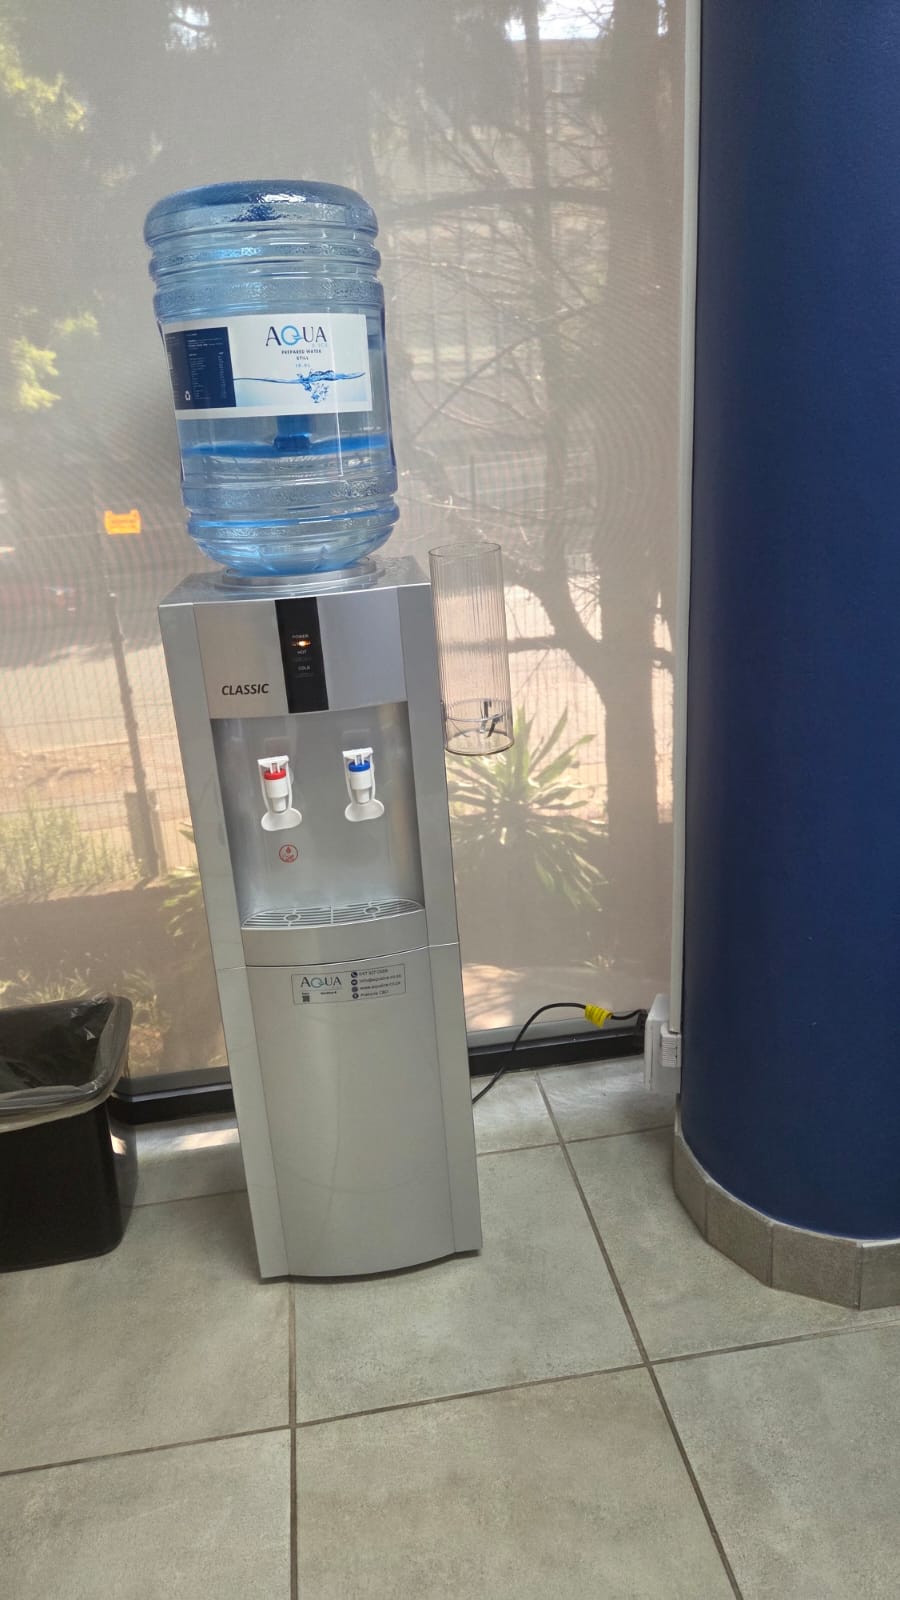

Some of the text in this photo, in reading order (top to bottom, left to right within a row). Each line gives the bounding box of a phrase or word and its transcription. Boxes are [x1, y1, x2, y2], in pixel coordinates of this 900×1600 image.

[265, 325, 327, 347] AQUA
[221, 683, 270, 696] CLASSIC
[300, 976, 342, 988] AQUA
